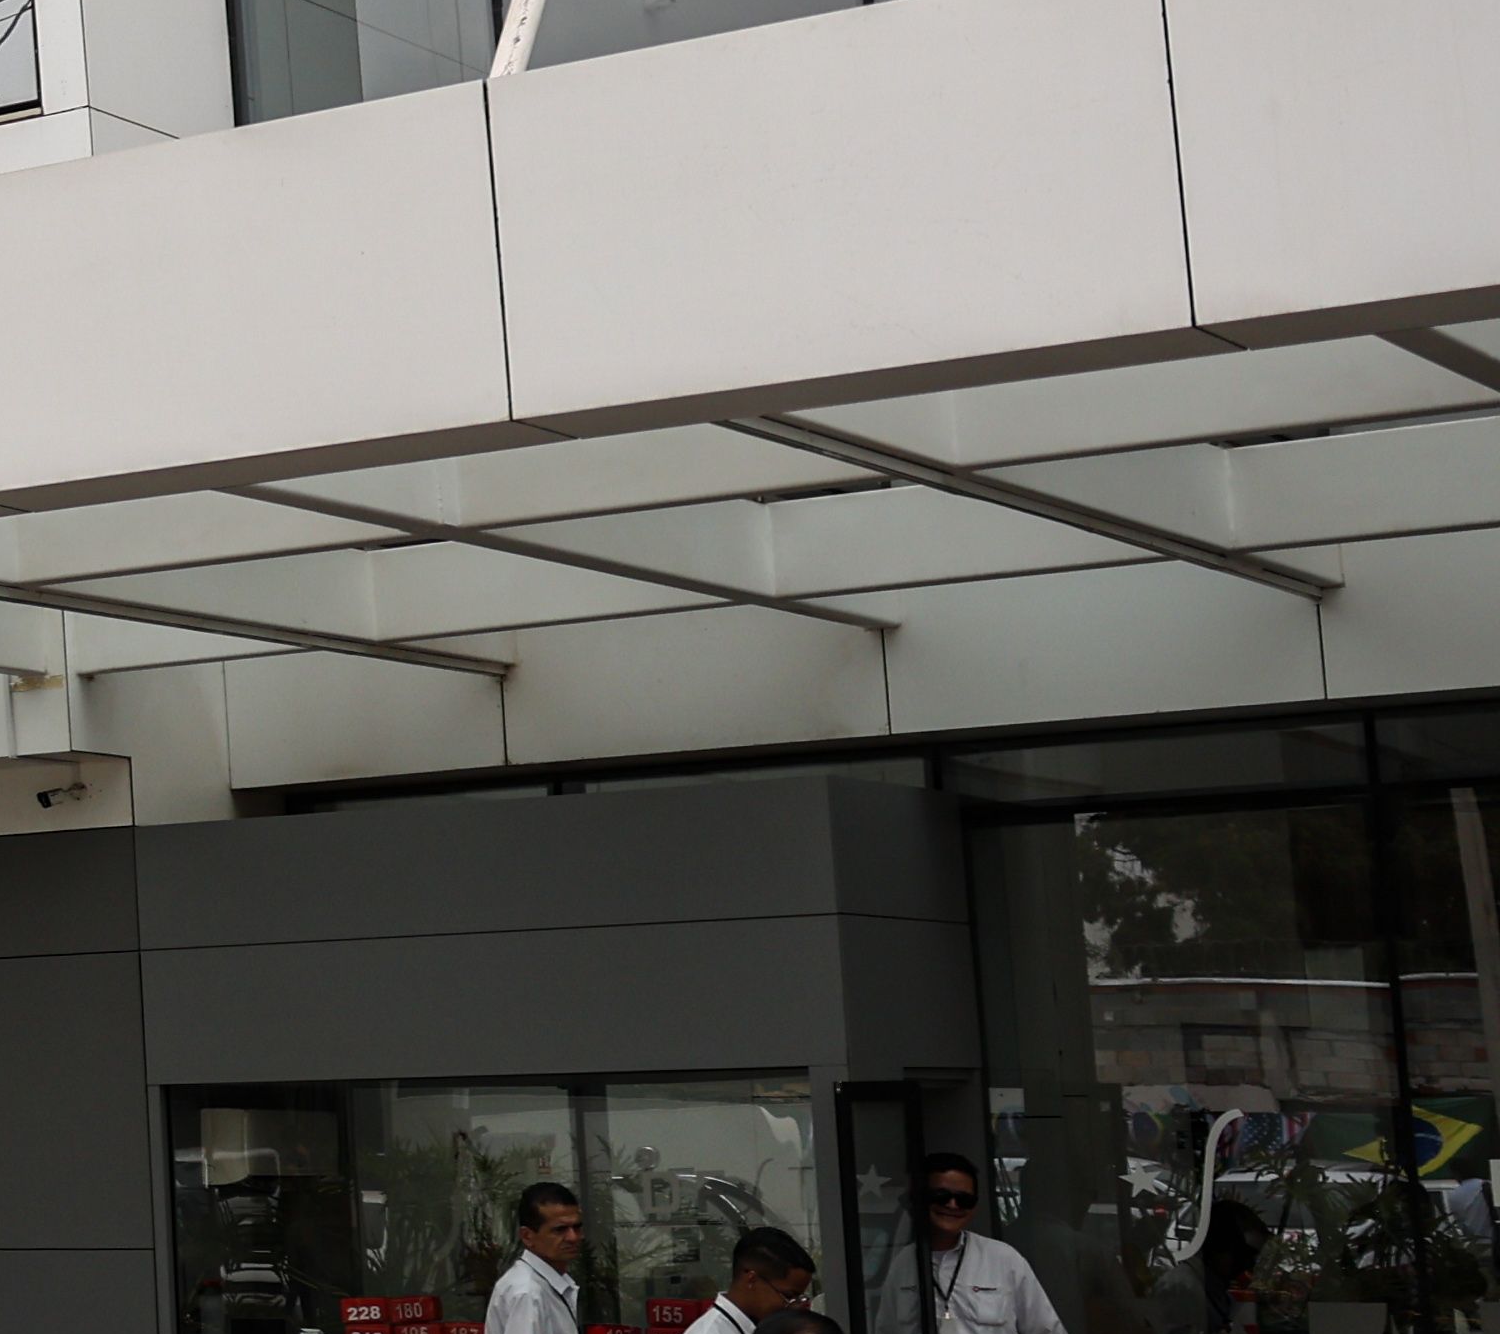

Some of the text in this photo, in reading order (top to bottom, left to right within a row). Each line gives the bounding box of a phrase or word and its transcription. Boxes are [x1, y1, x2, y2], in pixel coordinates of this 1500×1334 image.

[347, 1302, 423, 1321] 228 180
[652, 1305, 683, 1324] 155
